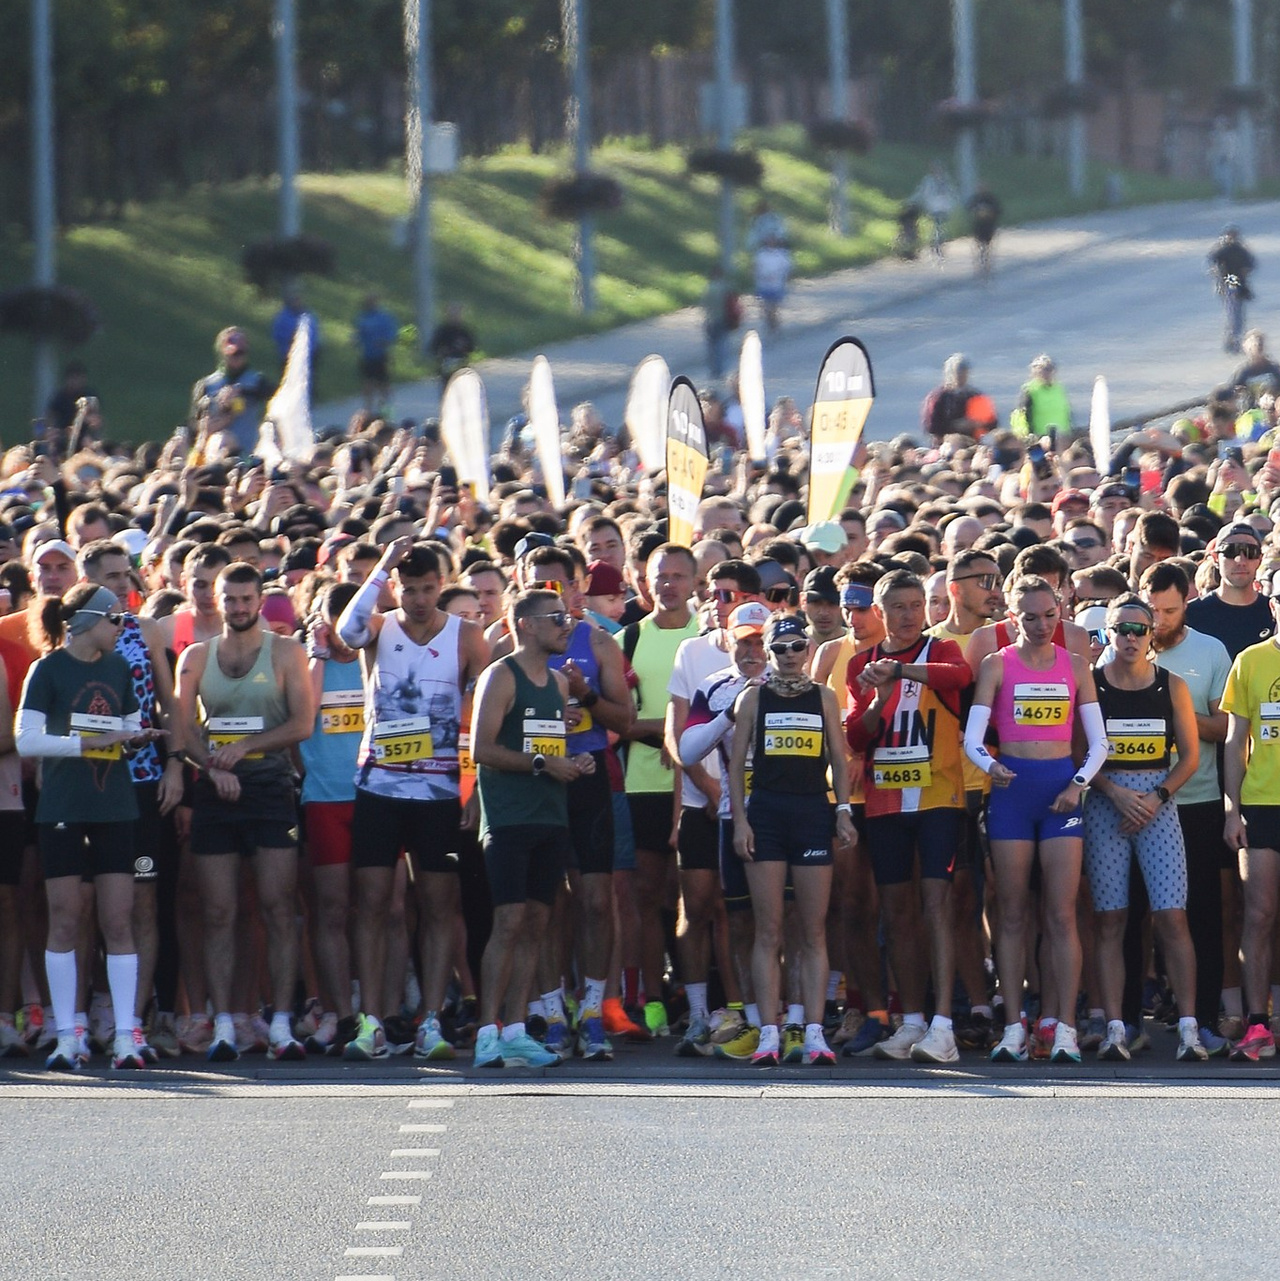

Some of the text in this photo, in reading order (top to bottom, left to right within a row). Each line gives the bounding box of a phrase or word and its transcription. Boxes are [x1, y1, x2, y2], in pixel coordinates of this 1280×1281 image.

[1023, 707, 1062, 719] 4675
[331, 714, 365, 727] 307
[1262, 728, 1269, 736] A
[384, 741, 423, 757] 5577
[774, 736, 814, 749] 3004
[1116, 743, 1156, 755] 3646
[883, 769, 922, 782] 4683
